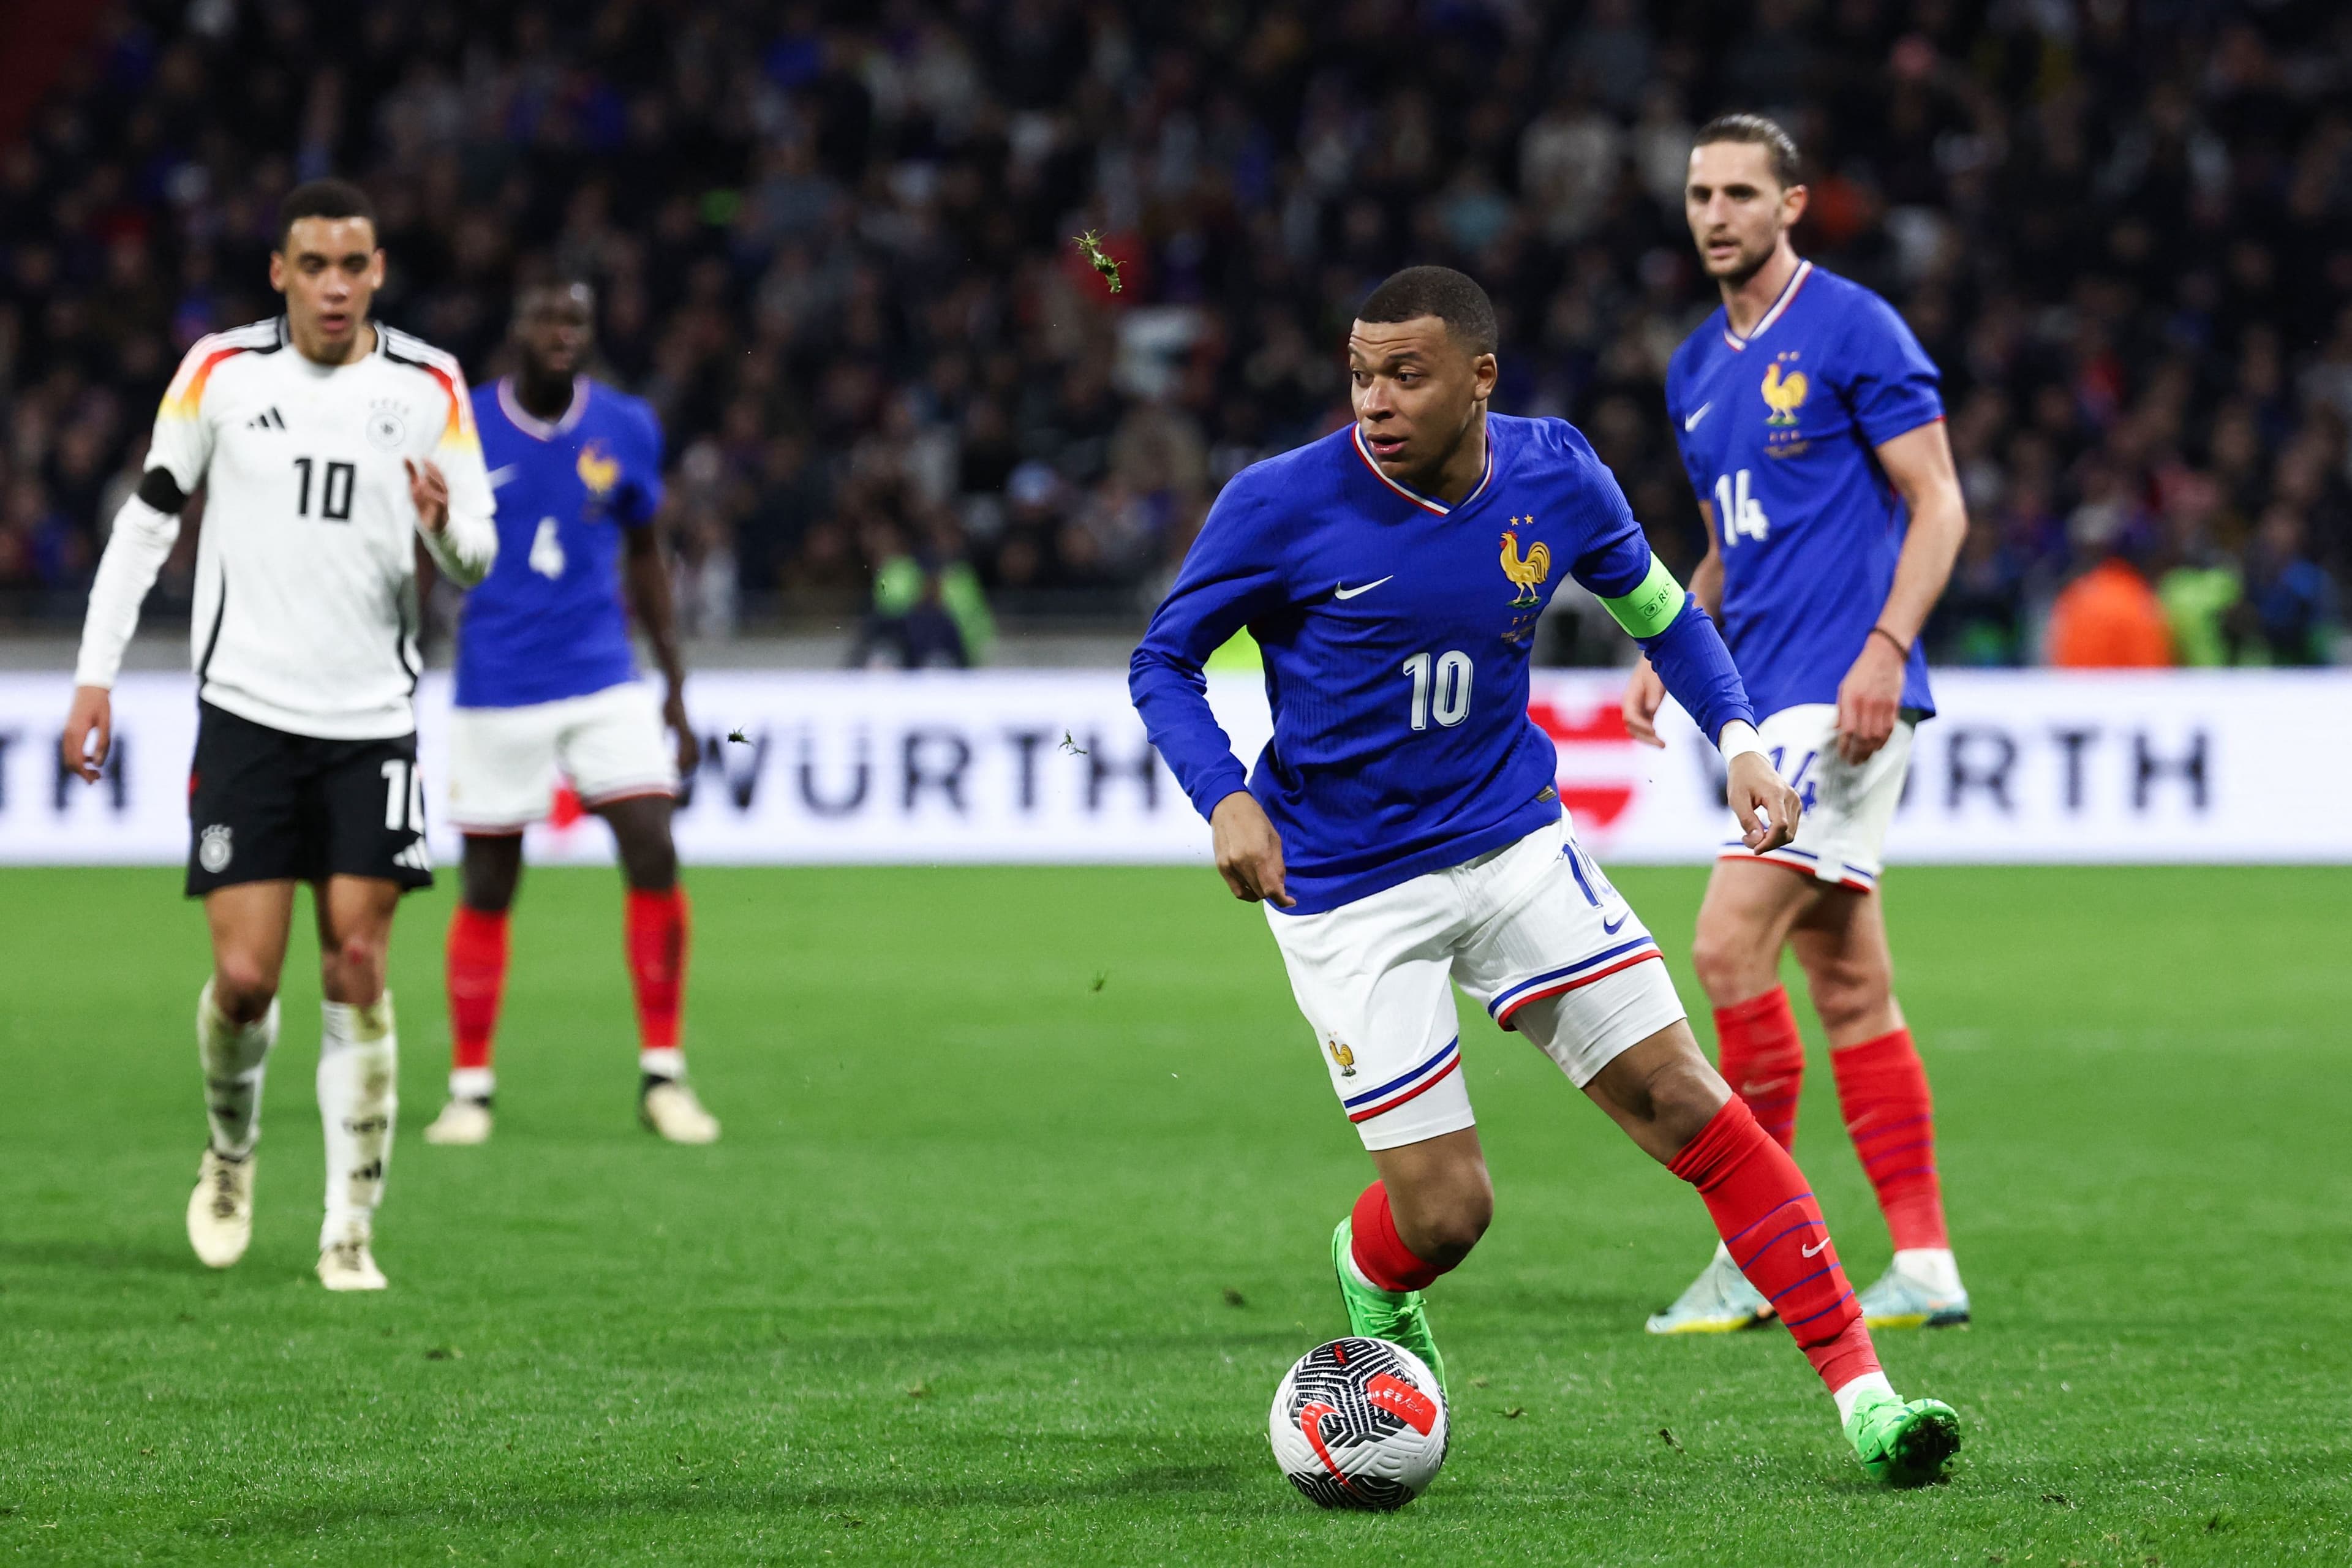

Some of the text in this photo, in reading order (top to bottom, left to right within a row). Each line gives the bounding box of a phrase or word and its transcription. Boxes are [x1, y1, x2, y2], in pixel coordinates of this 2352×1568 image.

[294, 458, 355, 522] 10
[1716, 469, 1770, 548] 14
[528, 516, 565, 580] 4
[1403, 650, 1473, 731] 10
[1382, 1388, 1424, 1415] 23/24
